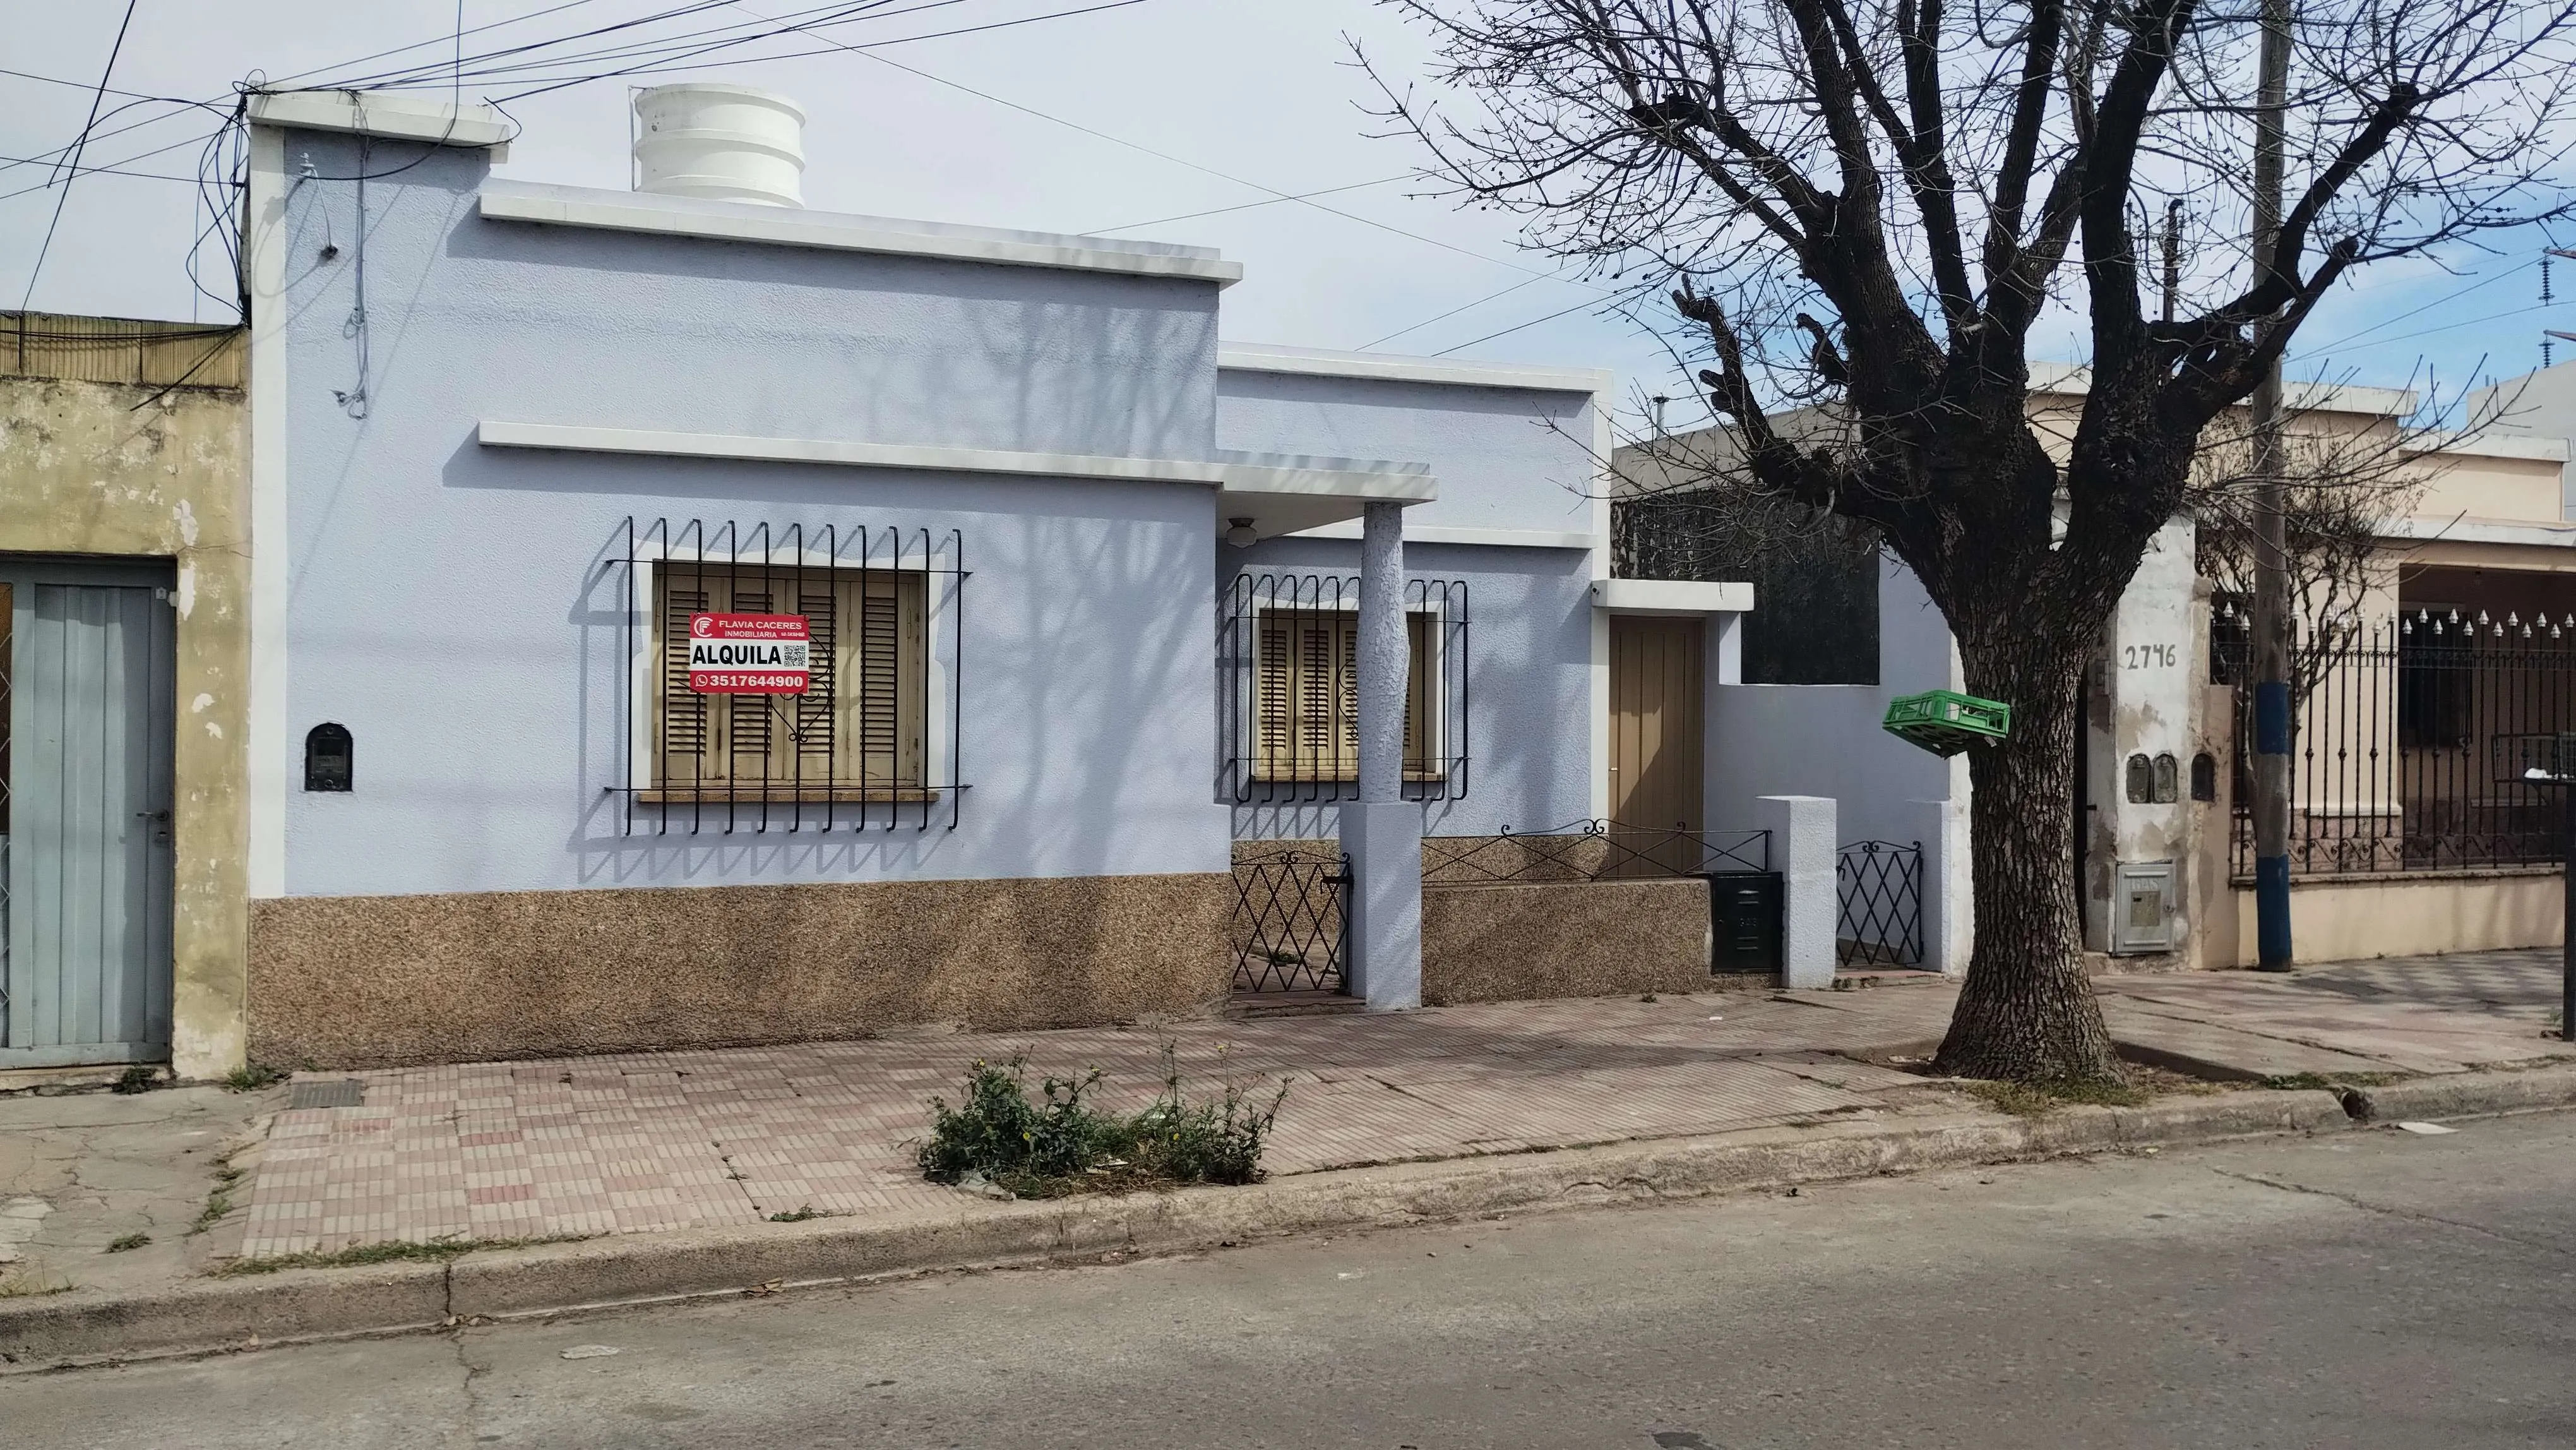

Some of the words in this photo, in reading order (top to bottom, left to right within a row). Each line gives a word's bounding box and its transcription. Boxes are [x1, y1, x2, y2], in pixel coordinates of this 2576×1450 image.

[719, 620, 754, 628] FLAVIA
[756, 621, 802, 630] CACERES
[692, 645, 782, 666] ALQUILA
[2125, 644, 2176, 670] 2746
[710, 675, 803, 687] 3517644900
